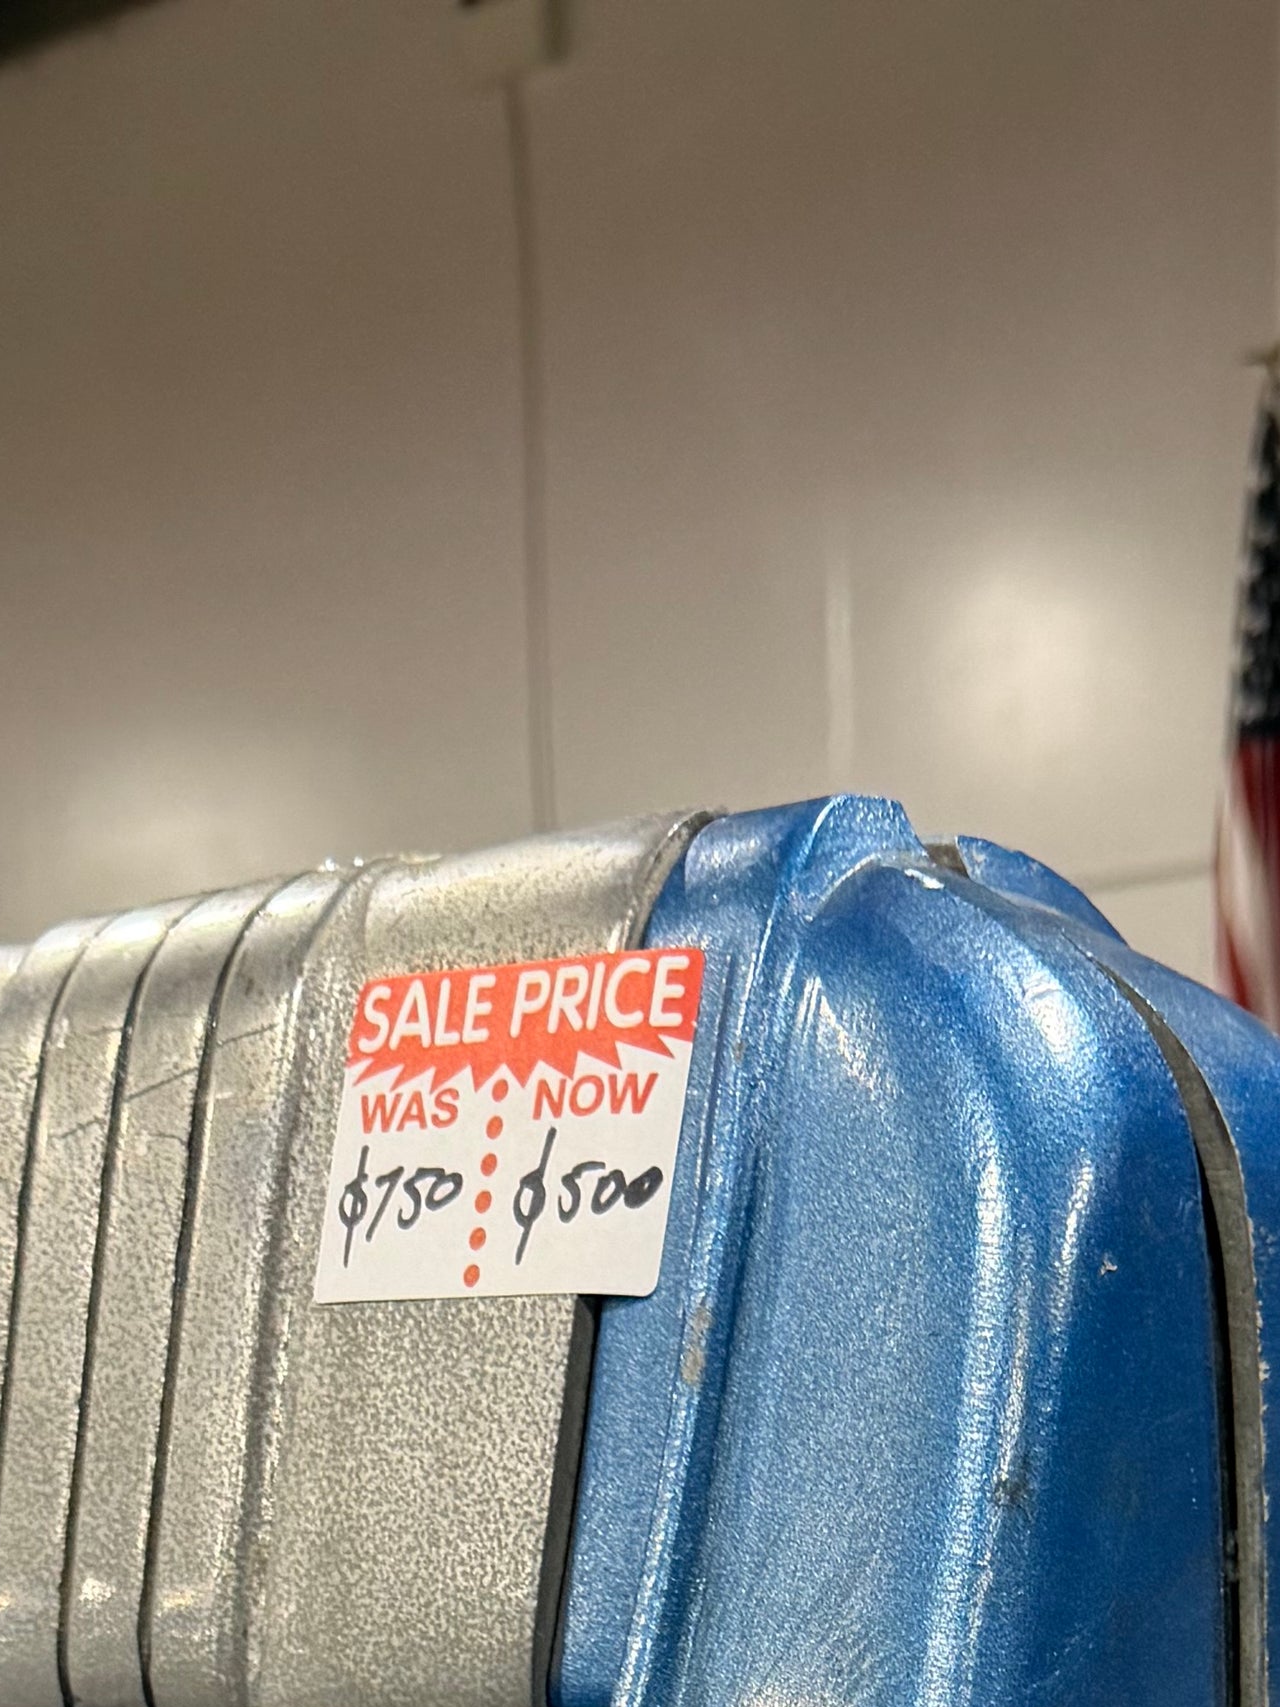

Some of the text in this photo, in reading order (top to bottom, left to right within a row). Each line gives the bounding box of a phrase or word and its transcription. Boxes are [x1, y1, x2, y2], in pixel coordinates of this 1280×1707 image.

[357, 955, 691, 1055] SALE PRICE
[360, 1071, 659, 1135] WAS NOW
[338, 1127, 664, 1268] $750 $500
